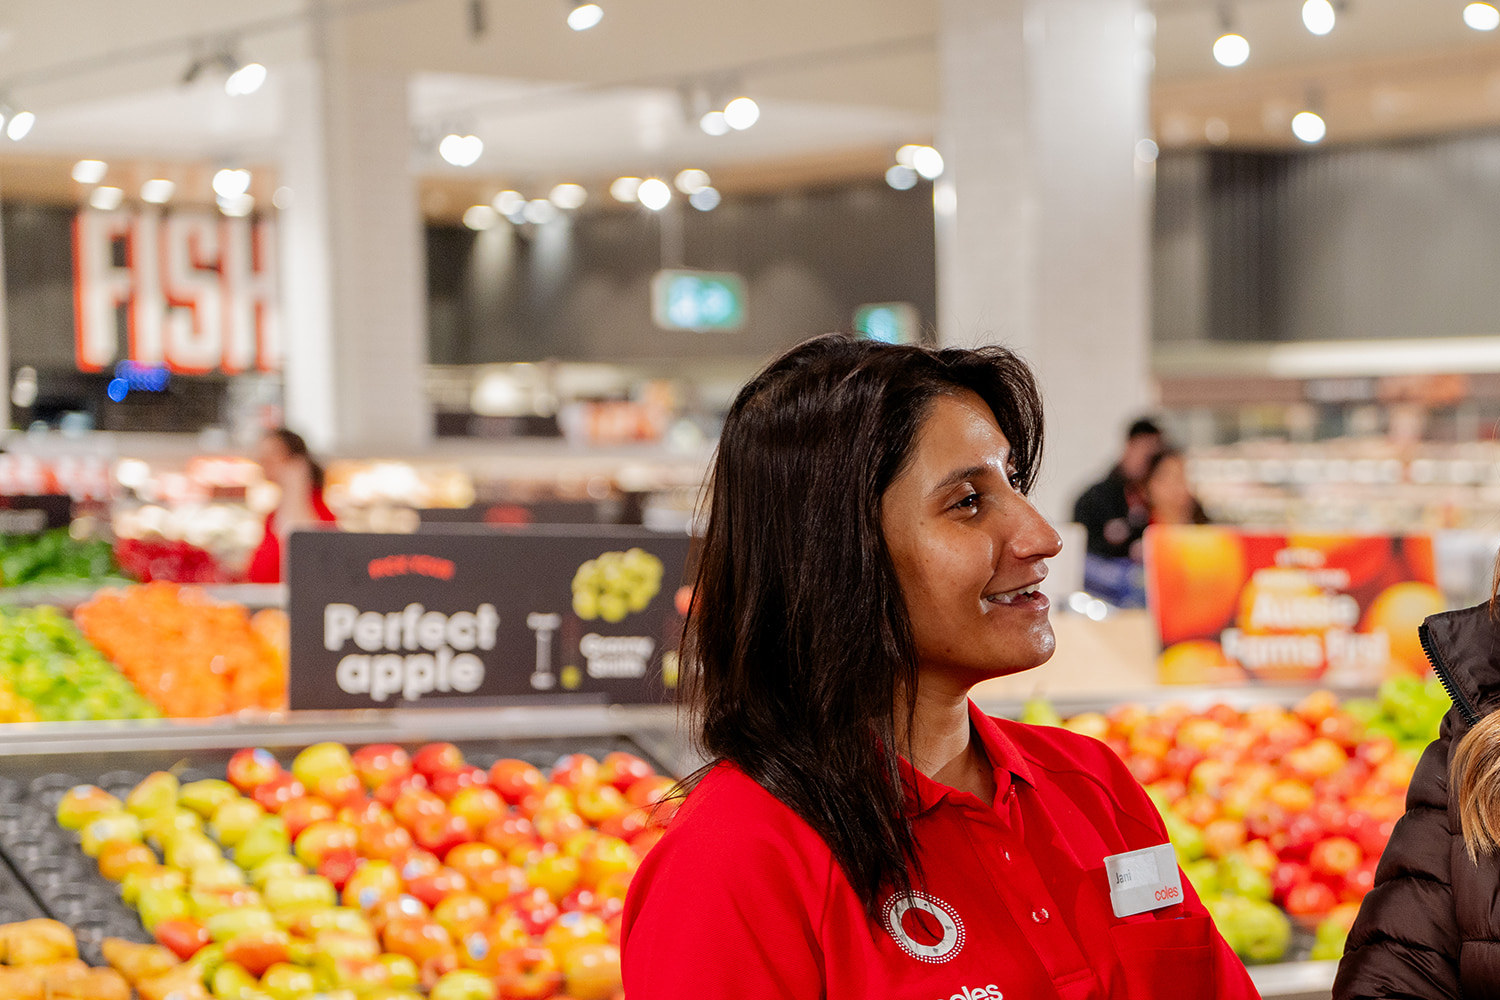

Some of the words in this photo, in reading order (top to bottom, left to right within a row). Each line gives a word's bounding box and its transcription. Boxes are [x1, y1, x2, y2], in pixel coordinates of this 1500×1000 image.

[71, 207, 283, 375] FISH
[324, 602, 499, 652] Perfect
[336, 647, 486, 701] apple
[1154, 885, 1179, 902] coles
